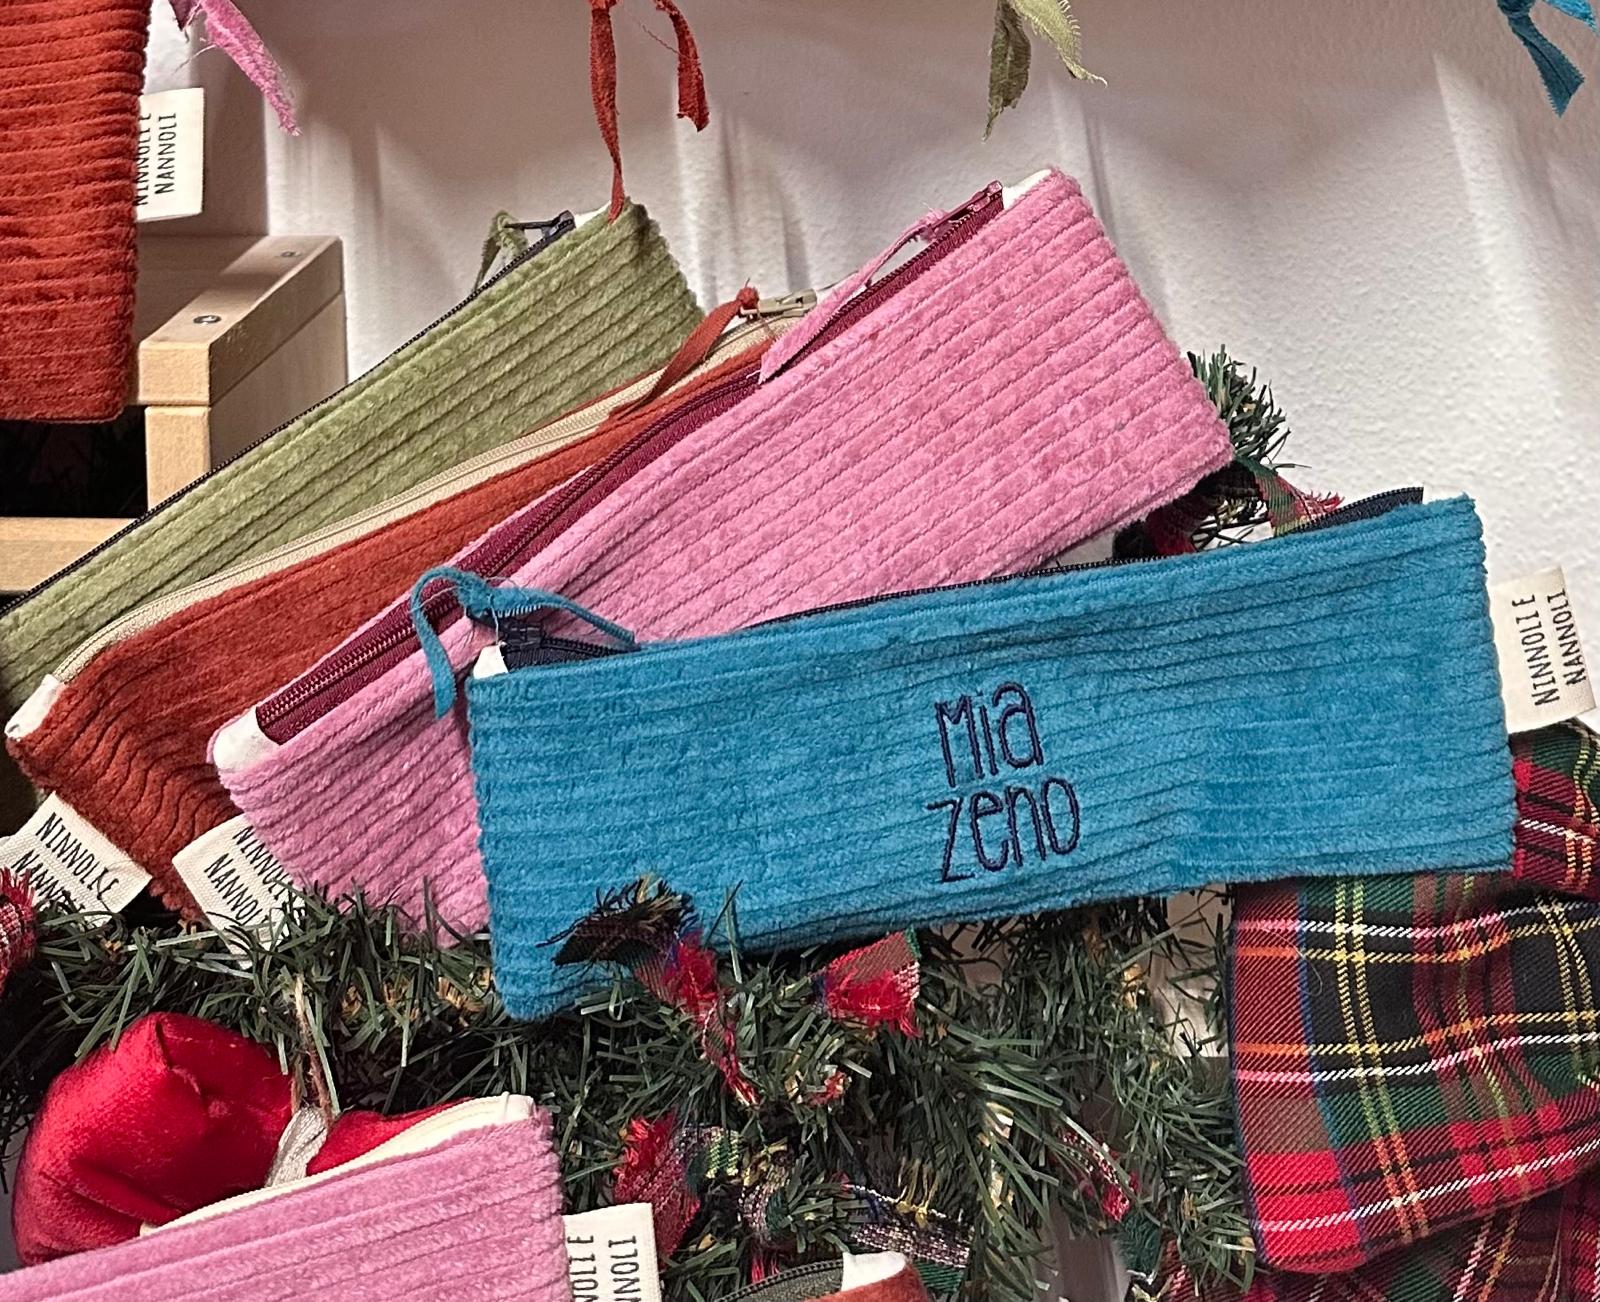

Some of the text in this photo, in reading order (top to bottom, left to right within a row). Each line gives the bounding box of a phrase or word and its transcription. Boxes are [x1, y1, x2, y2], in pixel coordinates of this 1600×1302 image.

[154, 112, 177, 194] NANNOLI
[1511, 594, 1560, 706] NINNOLI E
[1547, 588, 1587, 686] NANNOLI
[935, 681, 1044, 788] Mia
[35, 812, 109, 891] NINNOLI
[566, 1235, 594, 1244] E
